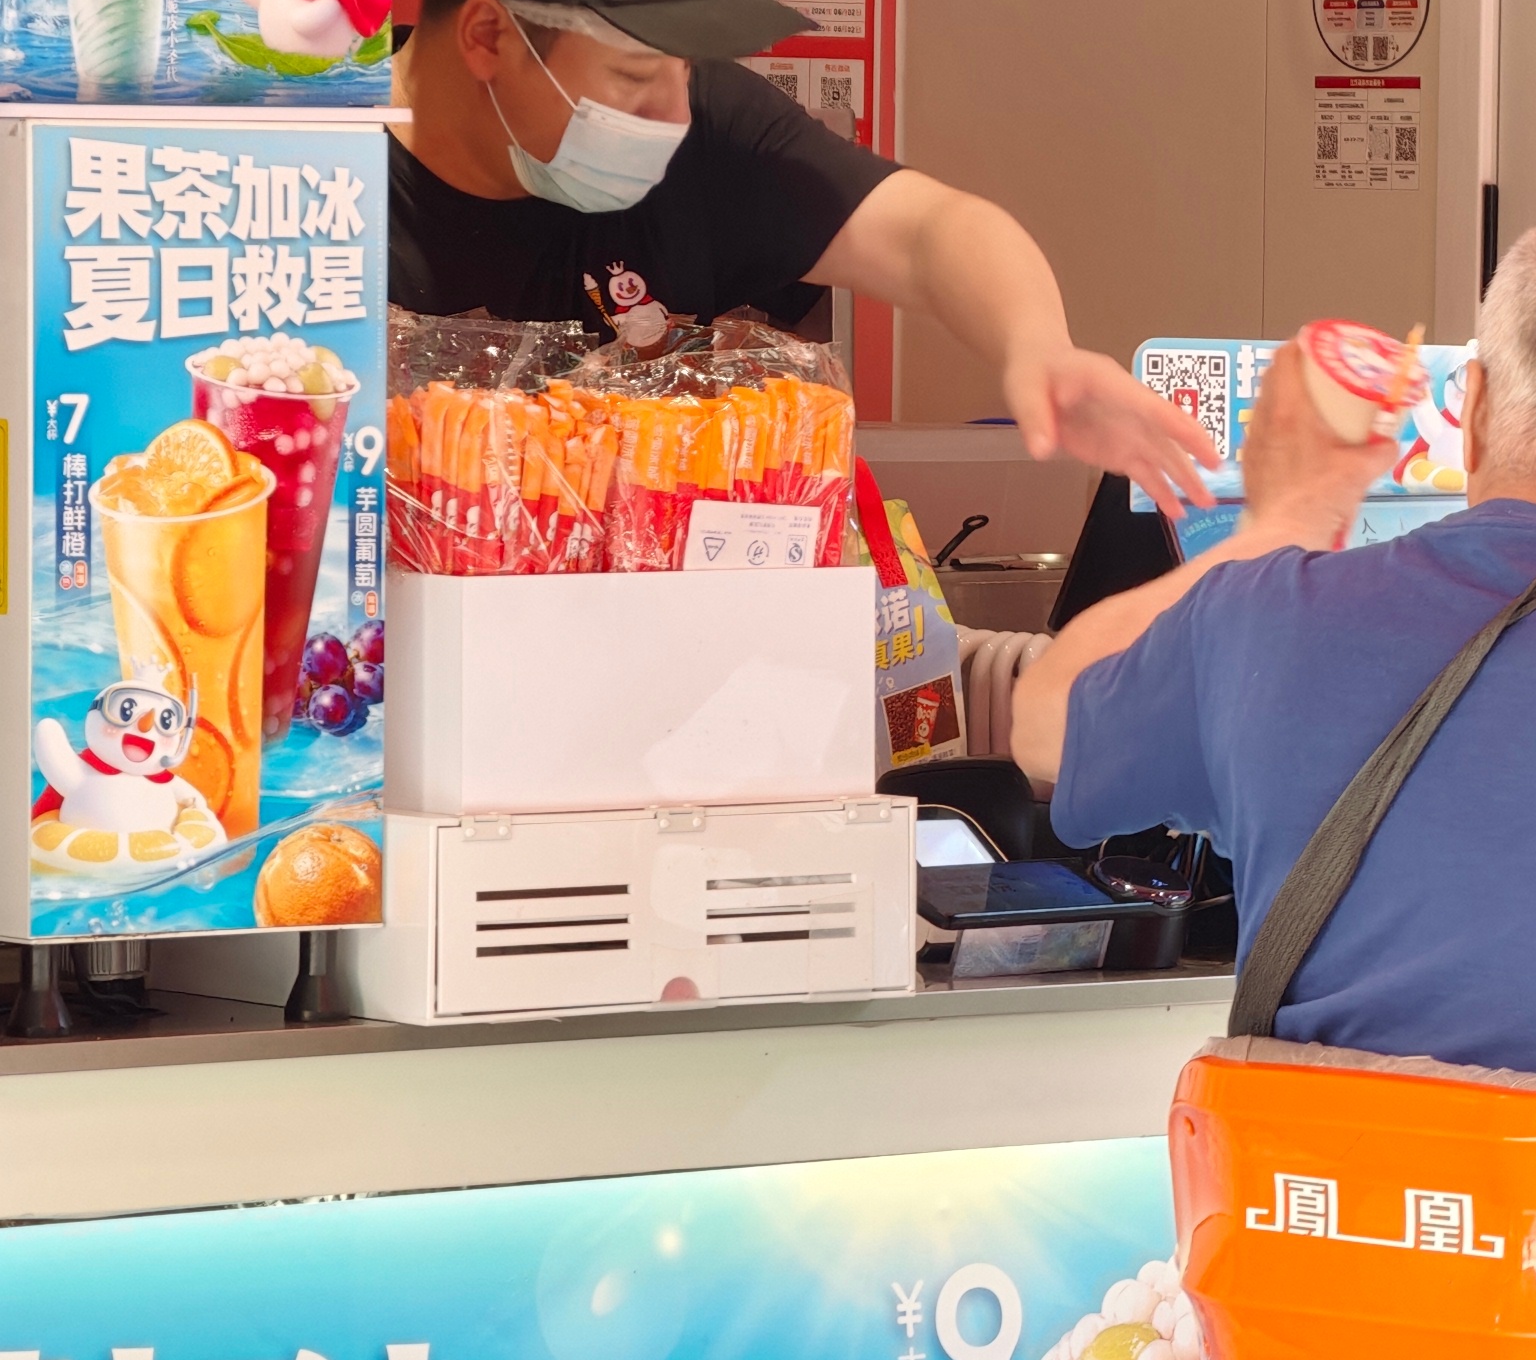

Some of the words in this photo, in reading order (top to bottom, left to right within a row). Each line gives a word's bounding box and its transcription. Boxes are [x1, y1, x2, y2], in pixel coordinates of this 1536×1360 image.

[63, 136, 367, 243] 果茶加冰
[63, 244, 369, 352] 夏日救星
[61, 452, 88, 558] 棒打鲜橙
[354, 486, 379, 588] 芋圆葡萄
